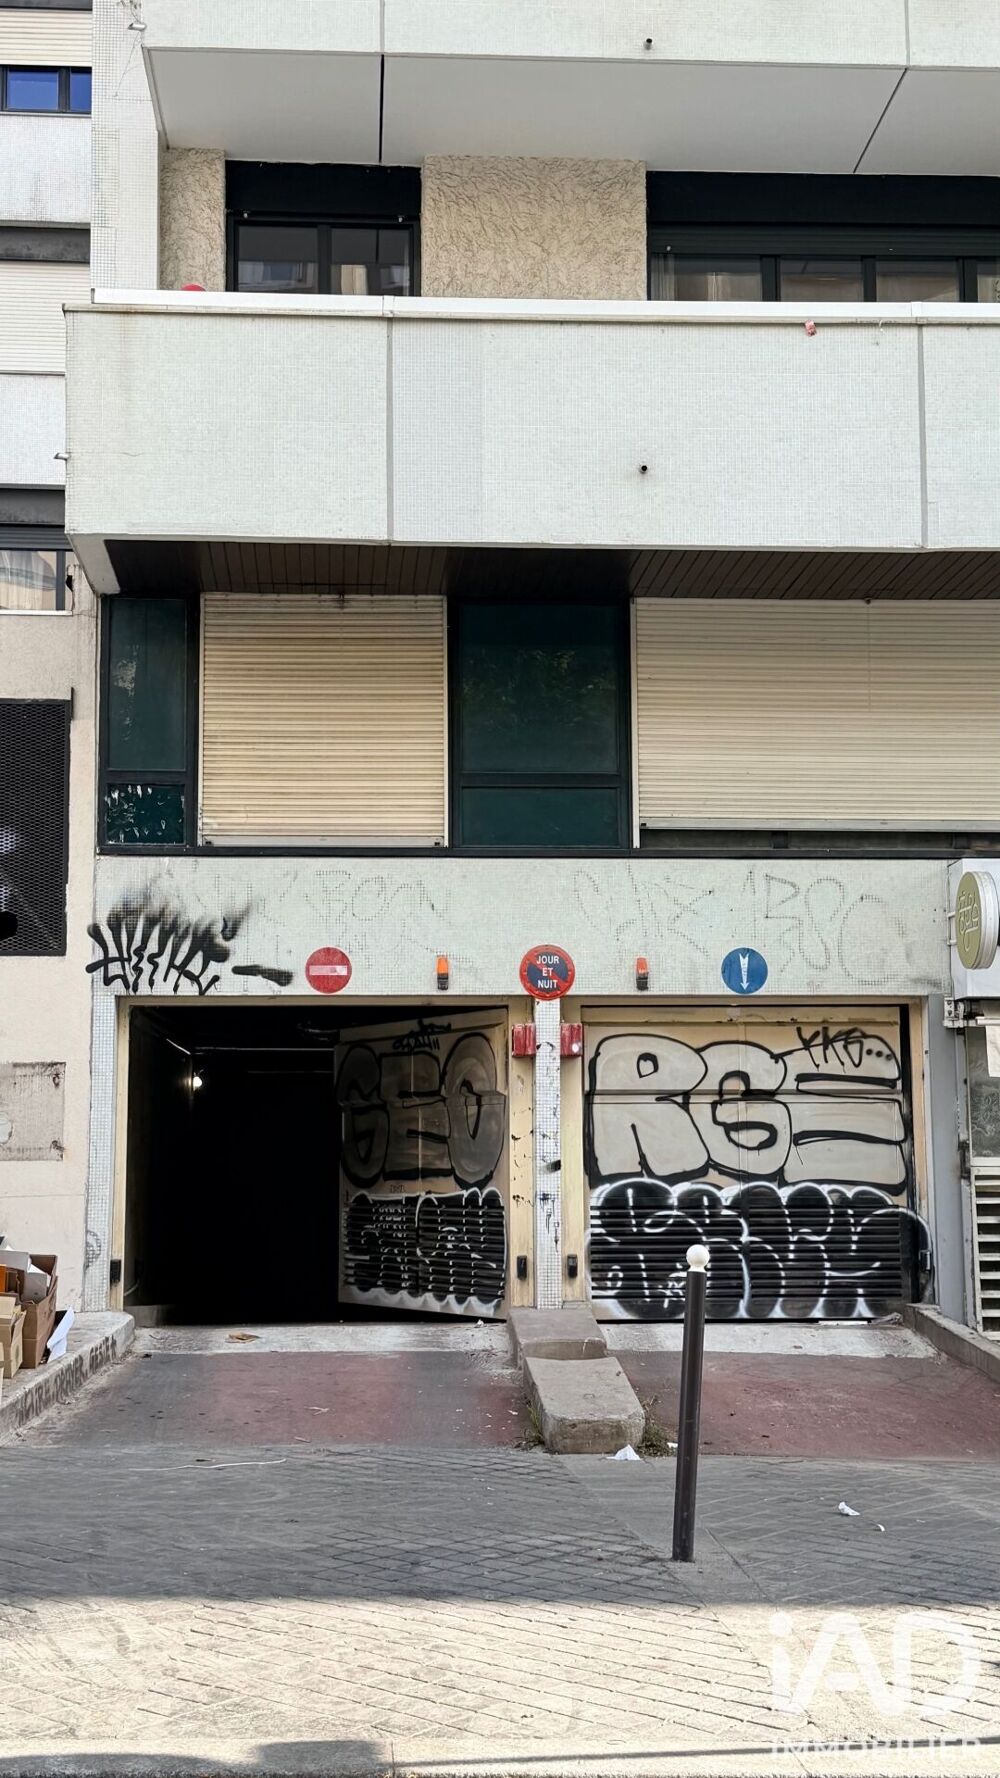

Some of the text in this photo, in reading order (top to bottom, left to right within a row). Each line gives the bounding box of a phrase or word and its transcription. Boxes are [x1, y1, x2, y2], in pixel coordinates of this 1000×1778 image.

[536, 955, 560, 965] JOUR
[542, 967, 554, 977] ET
[537, 979, 558, 989] NUIT
